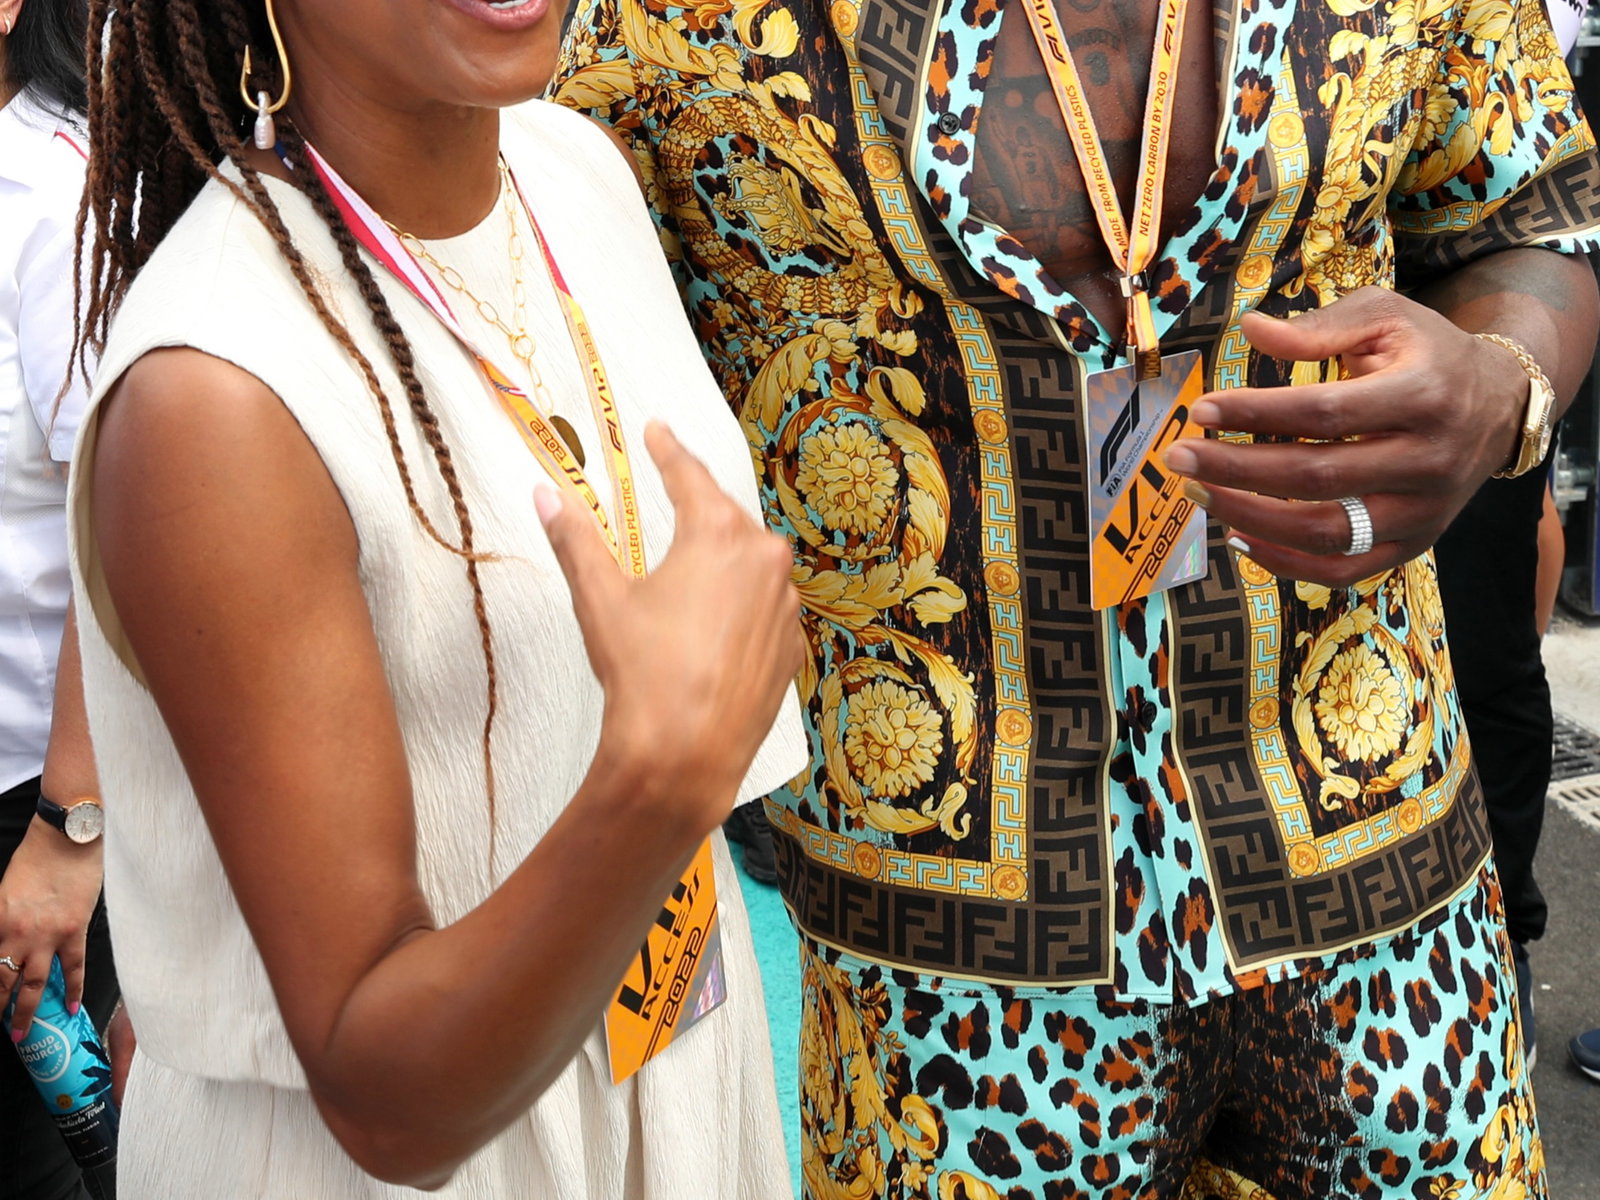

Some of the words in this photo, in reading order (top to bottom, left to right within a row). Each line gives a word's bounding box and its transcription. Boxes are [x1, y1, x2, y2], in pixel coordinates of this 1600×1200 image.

[1065, 85, 1087, 131] PLASTICS
[1155, 71, 1168, 102] 2030
[1152, 105, 1163, 123] BY
[1081, 134, 1105, 182] RECYCLED
[1146, 126, 1161, 176] CARBON
[1098, 184, 1115, 213] FROM
[1141, 178, 1155, 211] ZERO
[1110, 216, 1127, 247] MADE
[1139, 212, 1151, 236] NET
[577, 321, 598, 363] 2022
[529, 417, 567, 464] 2022
[1106, 477, 1121, 497] FIA
[1122, 456, 1135, 477] World
[619, 478, 636, 528] PLASTICS
[1125, 475, 1181, 564] ACCE
[631, 533, 645, 580] ECYCLED
[1145, 498, 1188, 579] 2022
[641, 867, 700, 1021] ACCESS
[663, 926, 701, 1028] 2022
[20, 1035, 55, 1054] PROUD
